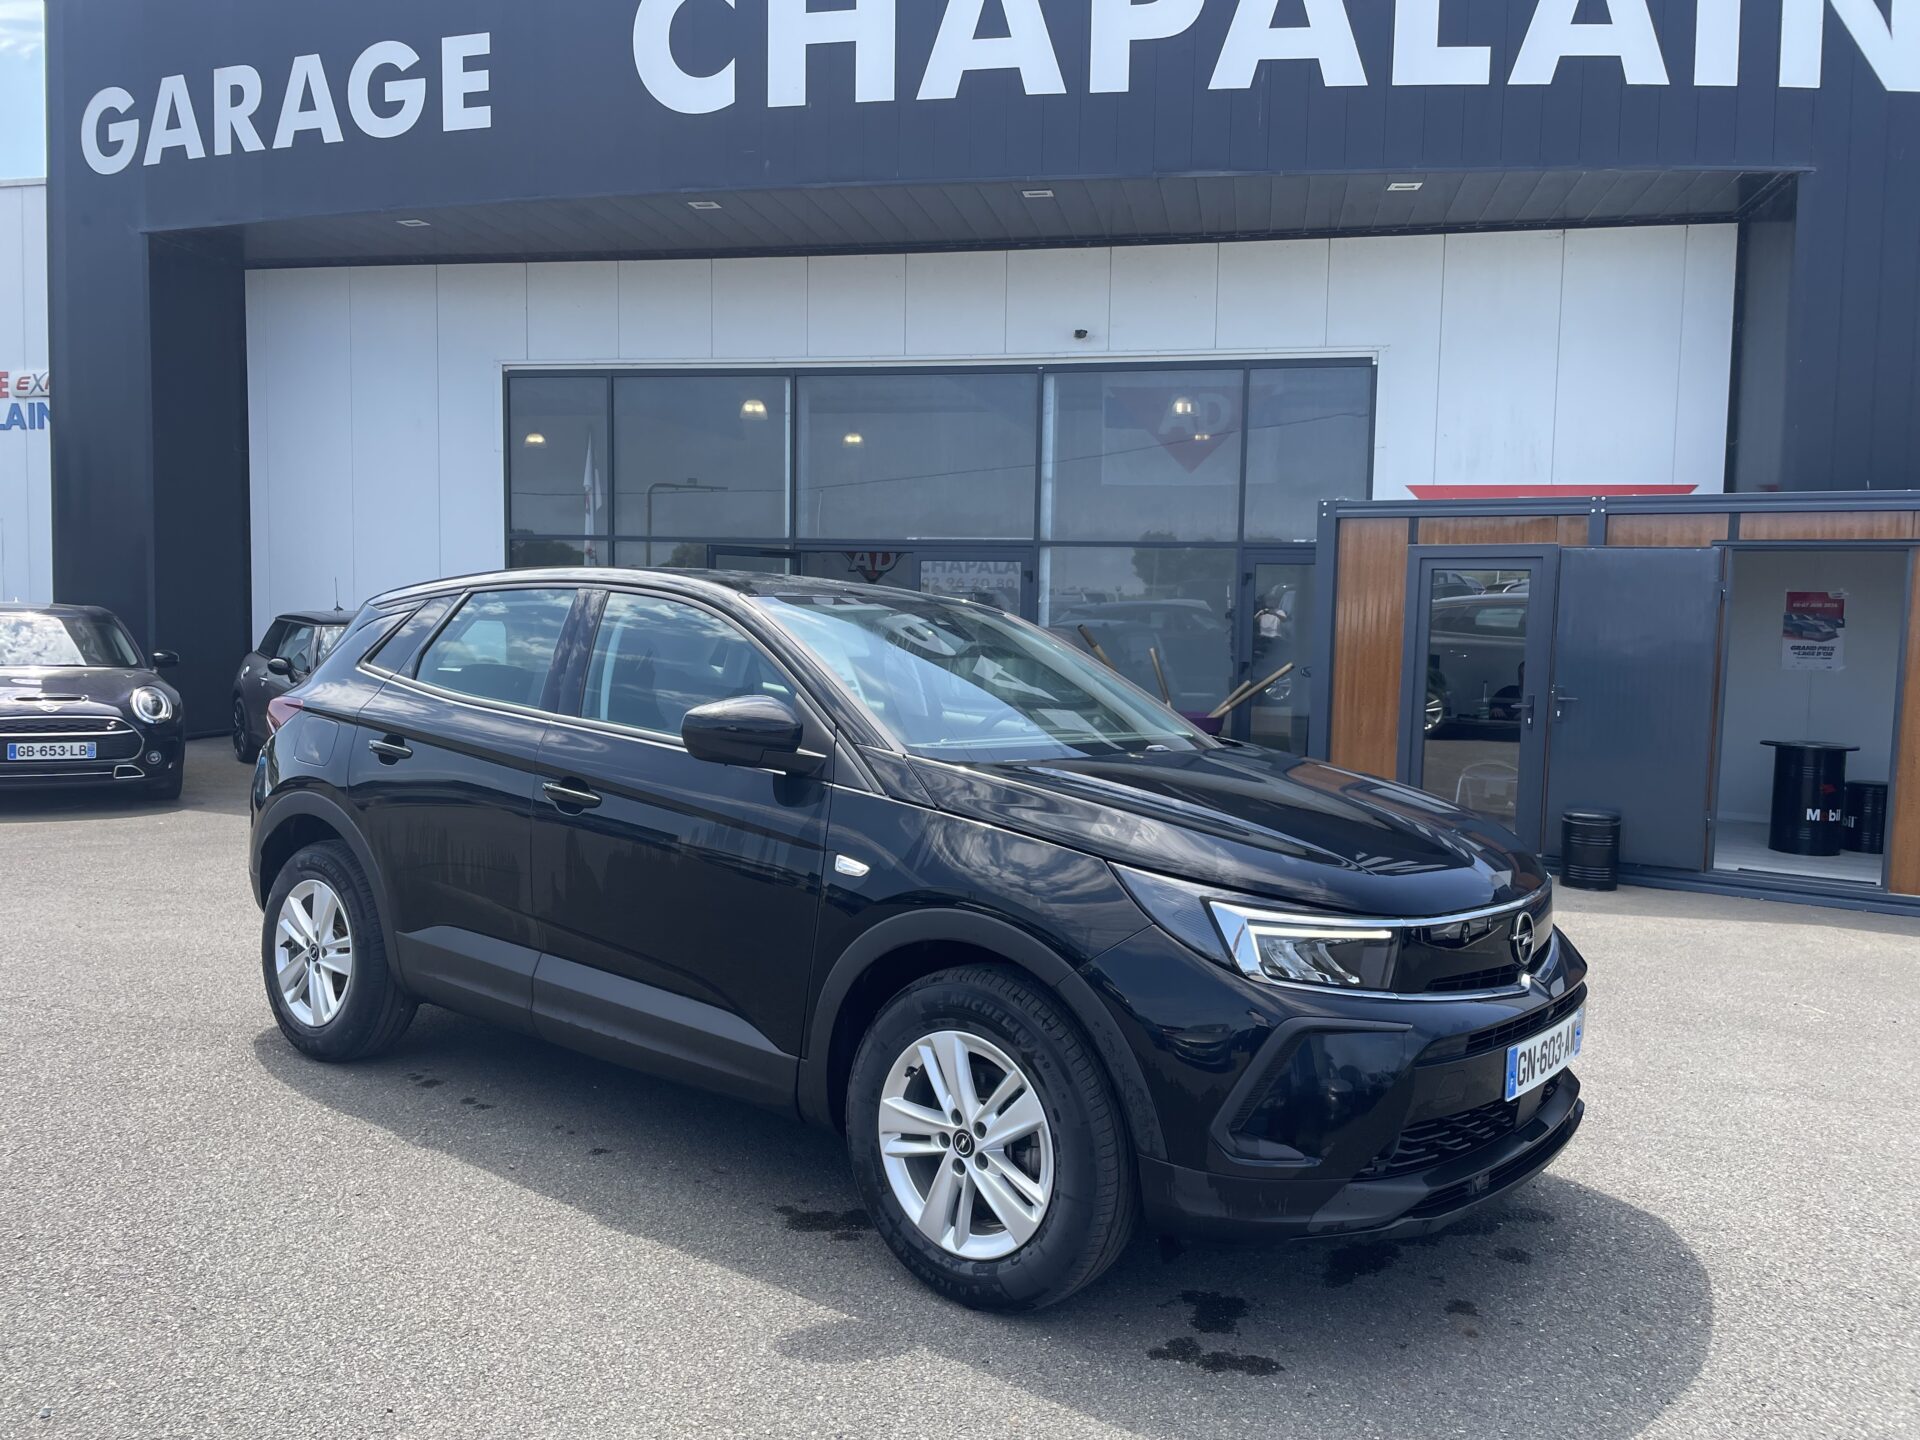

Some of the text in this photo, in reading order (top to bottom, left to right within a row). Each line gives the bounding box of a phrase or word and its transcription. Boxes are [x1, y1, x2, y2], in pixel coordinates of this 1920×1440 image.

[81, 0, 1920, 175] GARAGE CHAPALAIN
[0, 402, 50, 430] AIN
[1158, 393, 1231, 434] AD
[849, 552, 896, 571] AD
[17, 745, 87, 757] GB-653-LB
[1806, 808, 1841, 822] Mobil
